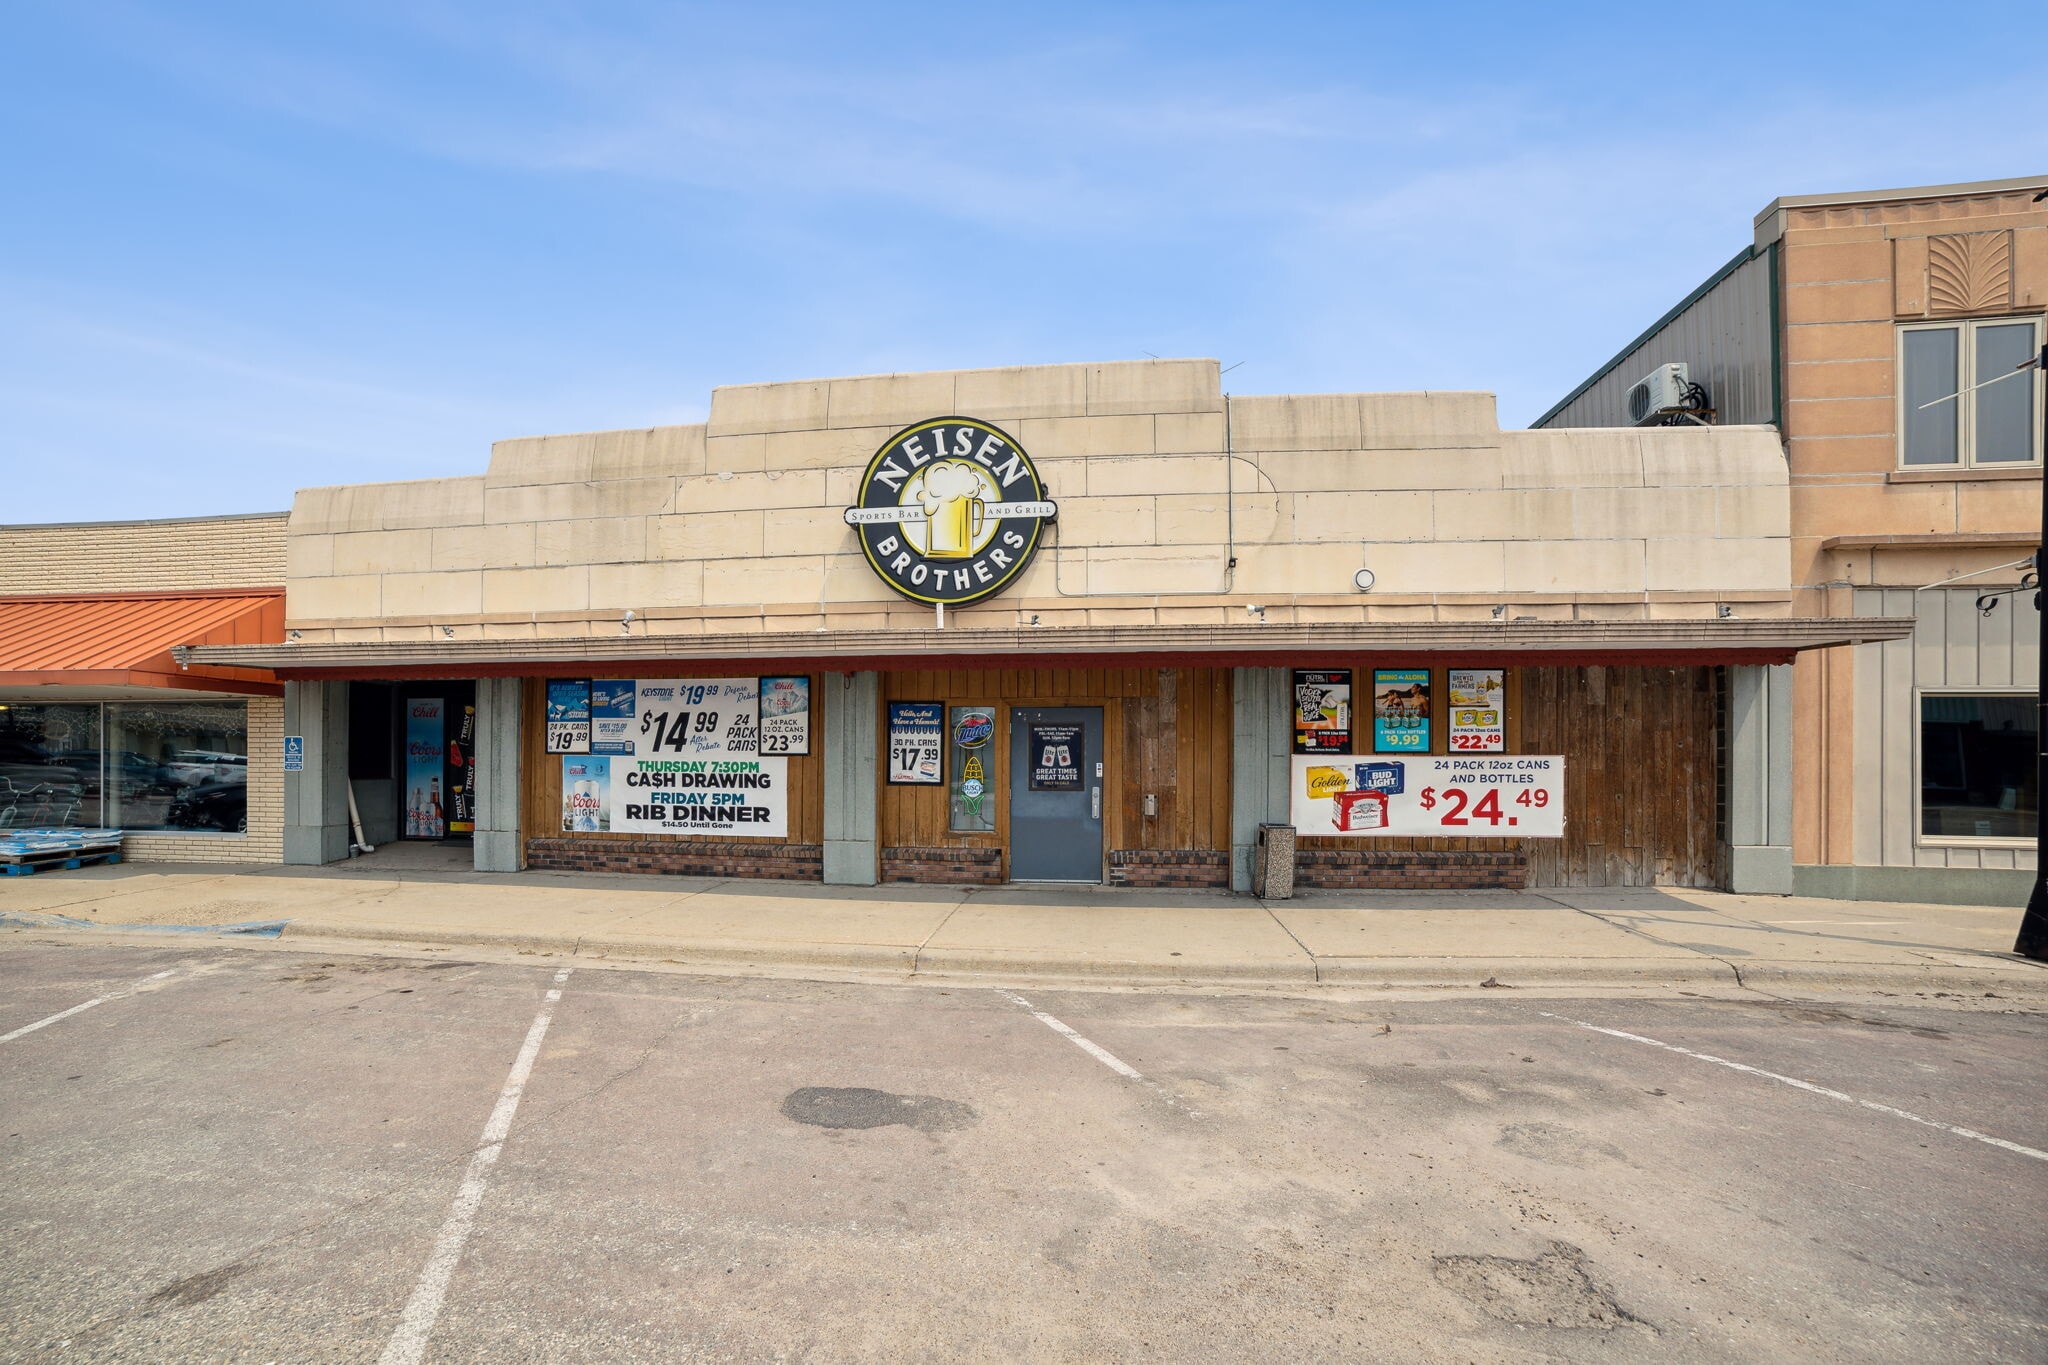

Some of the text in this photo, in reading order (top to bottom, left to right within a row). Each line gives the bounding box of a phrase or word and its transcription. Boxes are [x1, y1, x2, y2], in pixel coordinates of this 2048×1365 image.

[873, 427, 1031, 493] NEISEN
[987, 507, 1011, 515] AND
[876, 530, 1024, 592] BROTHERS
[641, 687, 675, 697] KEYSTONE
[412, 706, 440, 718] Chill
[734, 714, 751, 726] 24
[461, 714, 471, 739] TRULY
[726, 727, 758, 739] PACK
[549, 732, 588, 750] $19.99
[762, 734, 804, 751] $23.99
[894, 738, 903, 746] 30
[917, 739, 938, 747] CANS
[1386, 735, 1419, 746] $9.99
[410, 741, 441, 755] Coors
[892, 748, 938, 771] $17.99
[1434, 760, 1550, 770] 24 PACK 12oz CANS
[637, 761, 760, 773] THURSDAY 7:30PM
[465, 766, 474, 790] TRULY
[626, 771, 772, 789] CA$H DRAWING
[1371, 771, 1392, 779] BUD
[1450, 773, 1534, 784] AND BOTTLES
[962, 784, 984, 792] BUSCH
[1311, 775, 1351, 789] Golden
[1368, 778, 1396, 787] LIGHT
[572, 792, 601, 808] Coors
[651, 793, 745, 806] FRIDAY 5PM
[455, 794, 463, 820] TRULY
[574, 808, 599, 817] LIGHT
[626, 804, 771, 823] RIB DINNER
[661, 821, 689, 829] $14.50
[690, 821, 710, 829] Until
